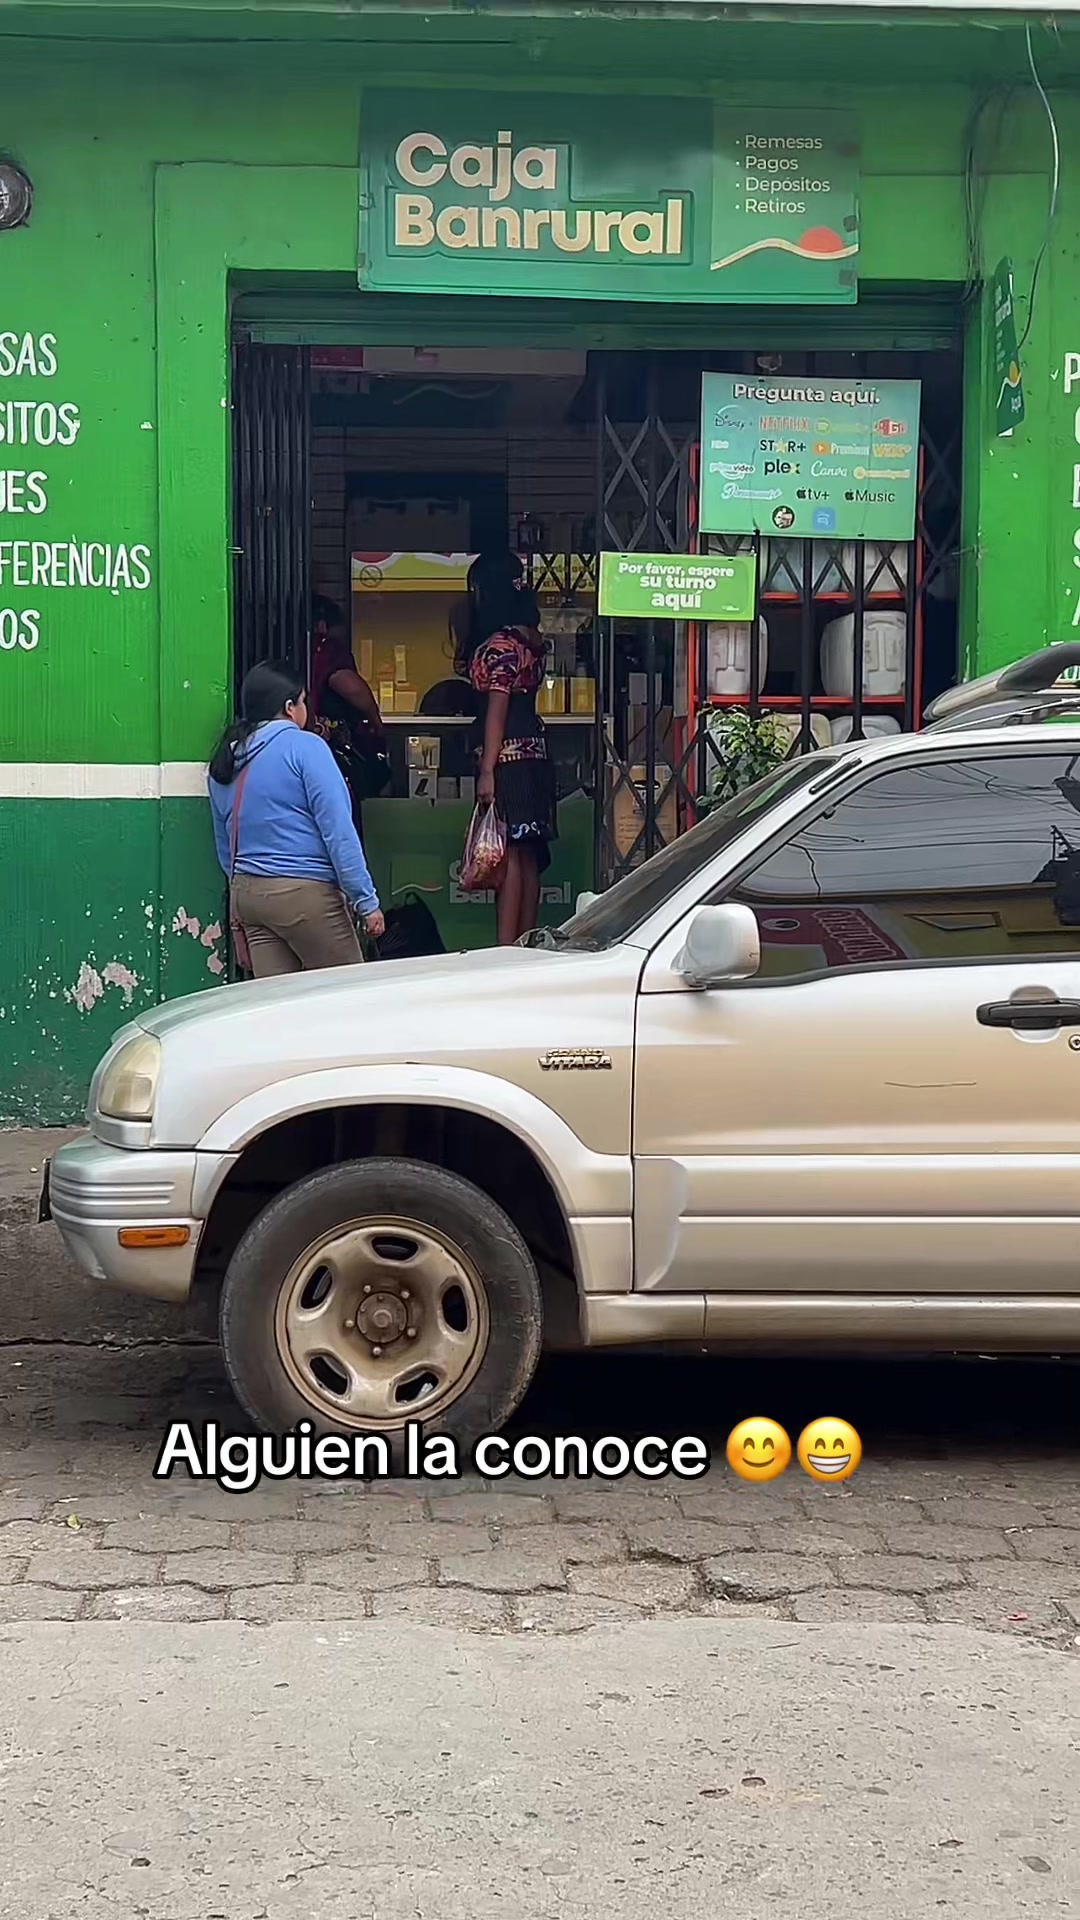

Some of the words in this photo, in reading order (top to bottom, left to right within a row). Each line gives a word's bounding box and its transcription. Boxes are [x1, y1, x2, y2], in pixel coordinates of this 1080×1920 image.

[745, 134, 823, 149] Remesas
[396, 131, 556, 201] Caja
[745, 155, 798, 173] Pagos
[745, 176, 831, 195] Depósitos
[745, 198, 806, 213] Retiros
[395, 194, 683, 254] Banrural
[733, 383, 825, 403] Pregunta
[811, 460, 847, 477] Canva
[855, 489, 895, 503] Music
[619, 562, 643, 574] Por
[646, 563, 685, 577] favor,
[688, 566, 734, 578] espere
[640, 576, 661, 588] su
[665, 575, 717, 589] turno
[652, 590, 703, 611] aquí
[538, 1055, 612, 1071] VITARA
